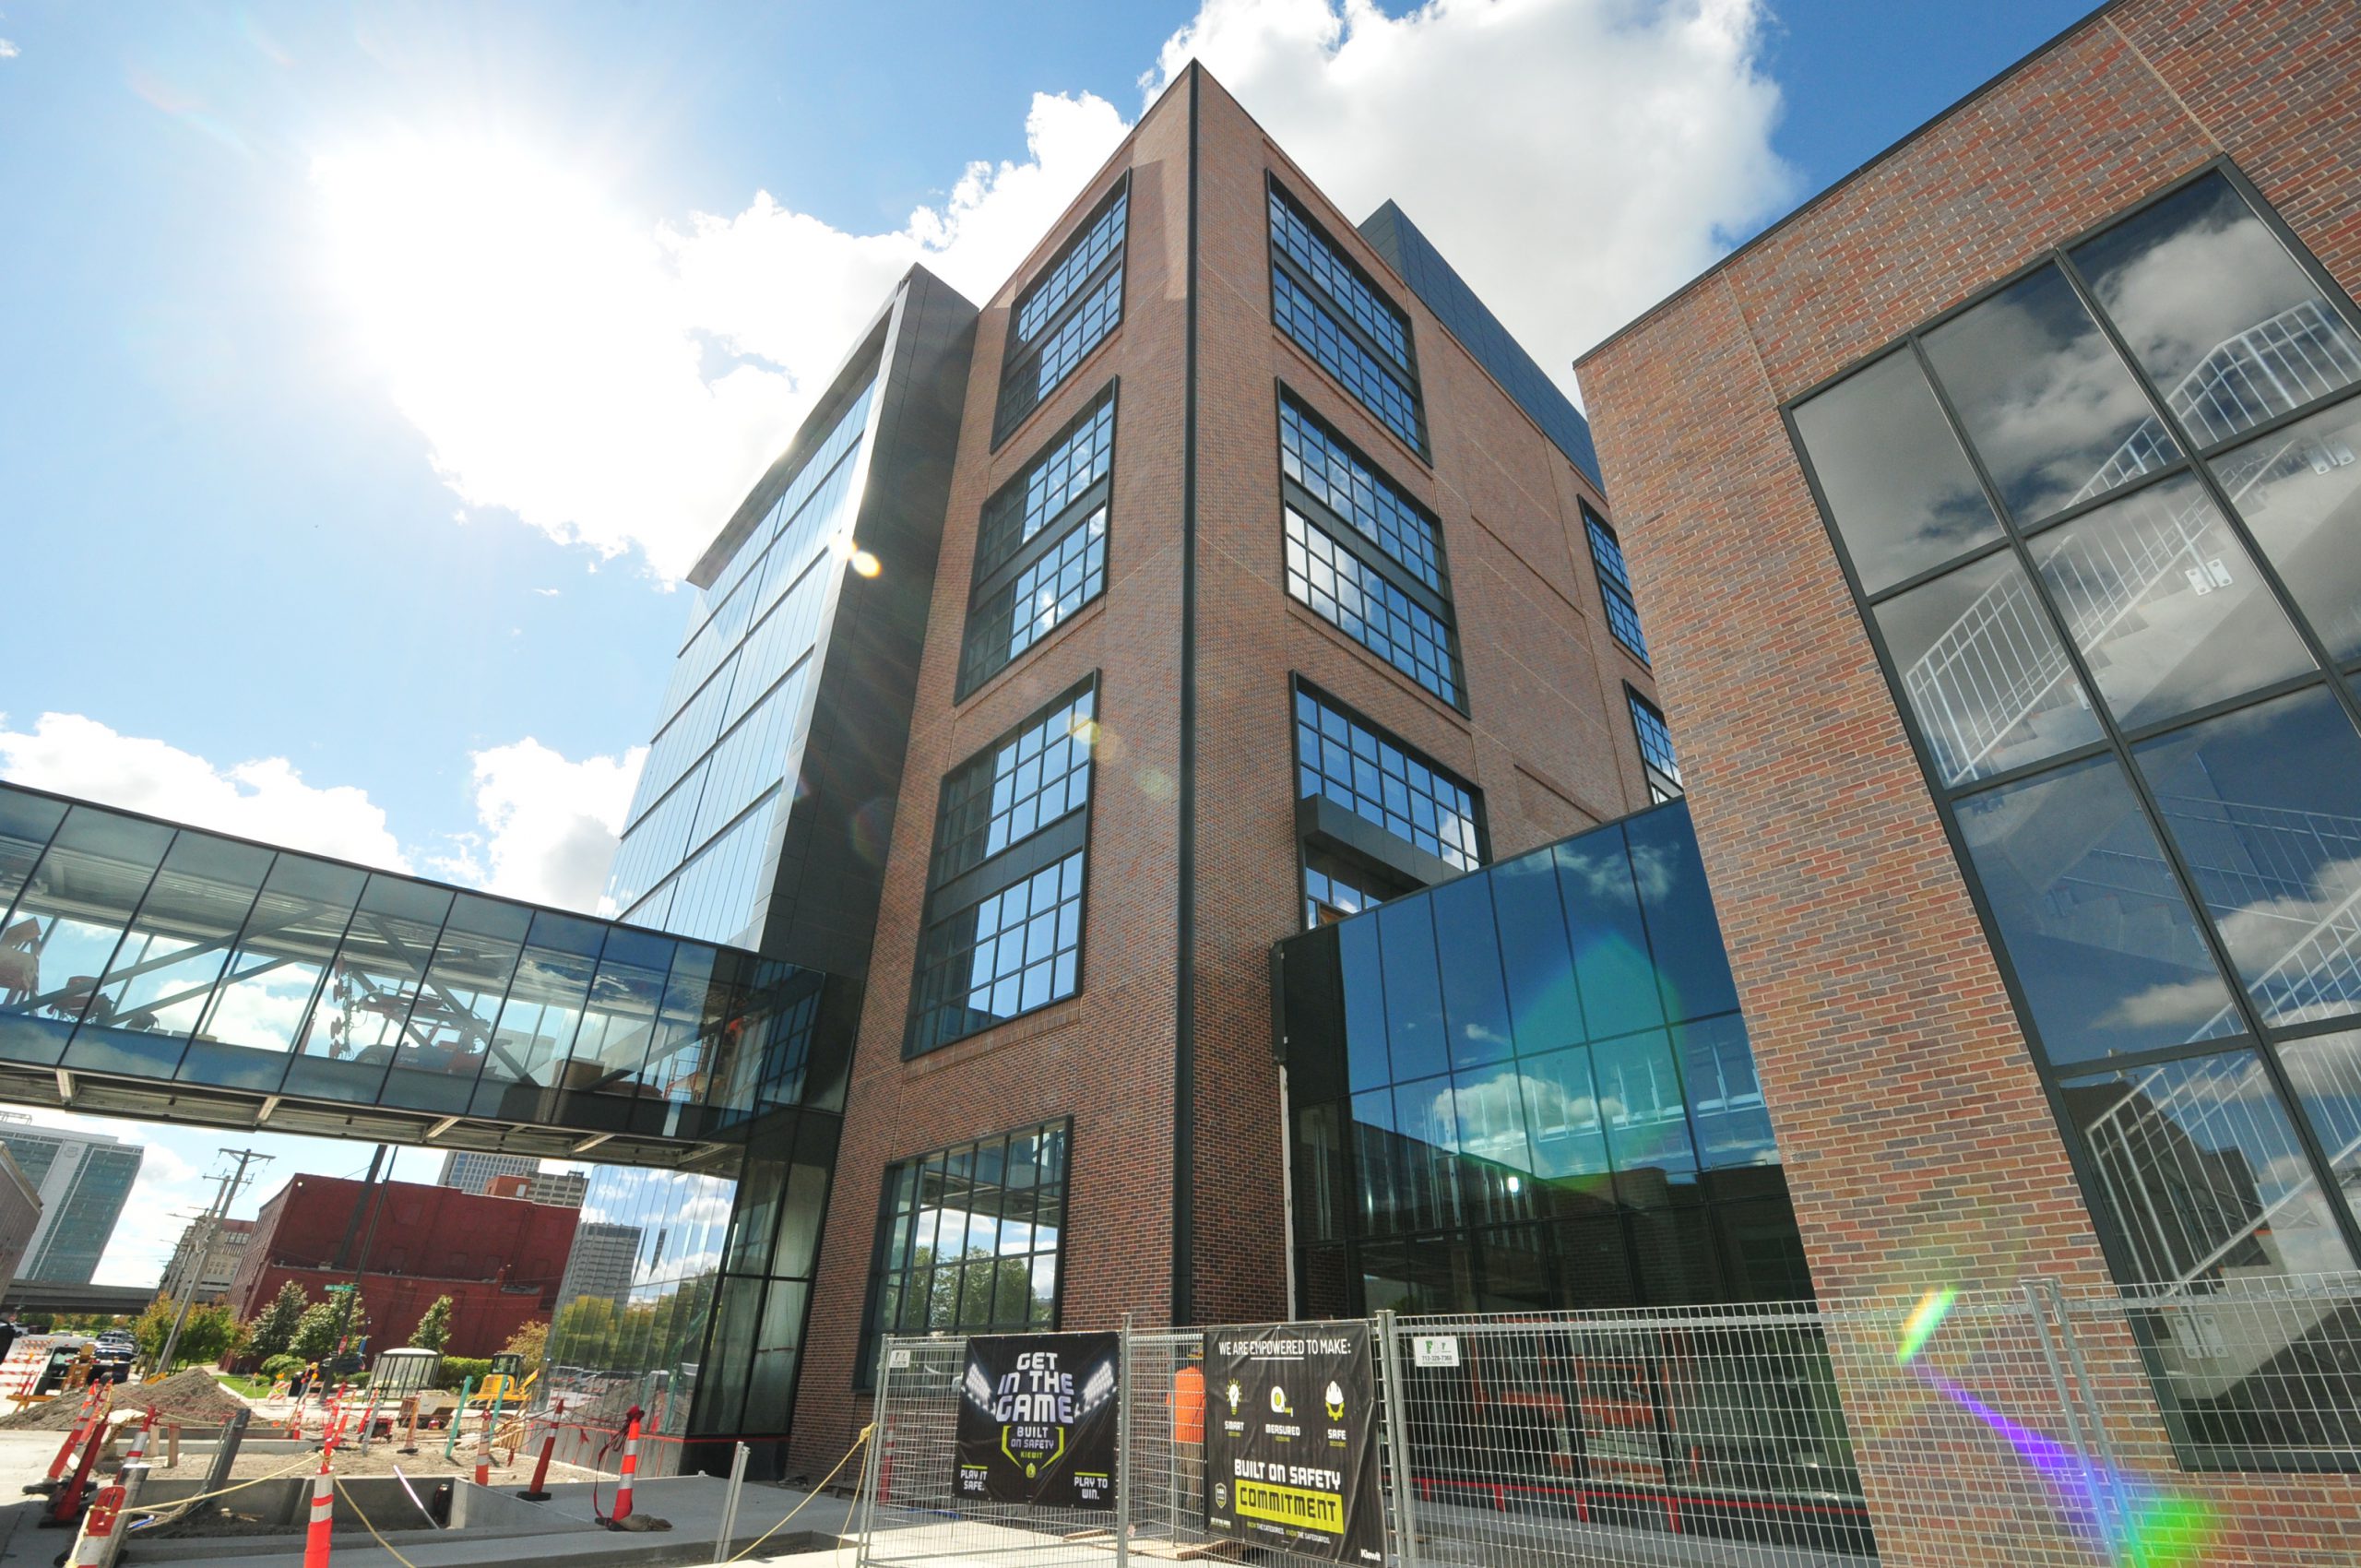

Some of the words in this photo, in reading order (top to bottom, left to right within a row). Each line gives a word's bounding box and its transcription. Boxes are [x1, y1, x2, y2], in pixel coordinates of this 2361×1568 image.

[1218, 1341, 1231, 1356] WE
[1232, 1341, 1249, 1356] ARE
[1250, 1339, 1304, 1356] EMPOWERED
[1306, 1339, 1319, 1355] TO
[1320, 1338, 1351, 1355] MAKE:
[1016, 1351, 1058, 1371] GET
[997, 1372, 1020, 1396] IN
[1029, 1371, 1074, 1396] THE
[995, 1394, 1074, 1424] GAME
[1224, 1420, 1244, 1431] SMART
[1265, 1423, 1300, 1437] MEASURED
[1016, 1426, 1049, 1439] BUILT
[1327, 1428, 1347, 1441] SAFE
[1011, 1438, 1022, 1448] ON
[1024, 1439, 1054, 1450] SAFETY
[960, 1469, 979, 1479] PLAY
[979, 1470, 988, 1480] IT
[1234, 1458, 1265, 1480] BUILT
[1268, 1463, 1287, 1483] ON
[1289, 1466, 1341, 1491] SAFETY
[964, 1480, 985, 1491] SAFE.
[1074, 1477, 1096, 1489] PLAY
[1097, 1478, 1109, 1489] TO
[1081, 1489, 1099, 1501] WIN.
[1240, 1486, 1336, 1522] COMMITMENT
[1360, 1548, 1382, 1562] Kiewit
